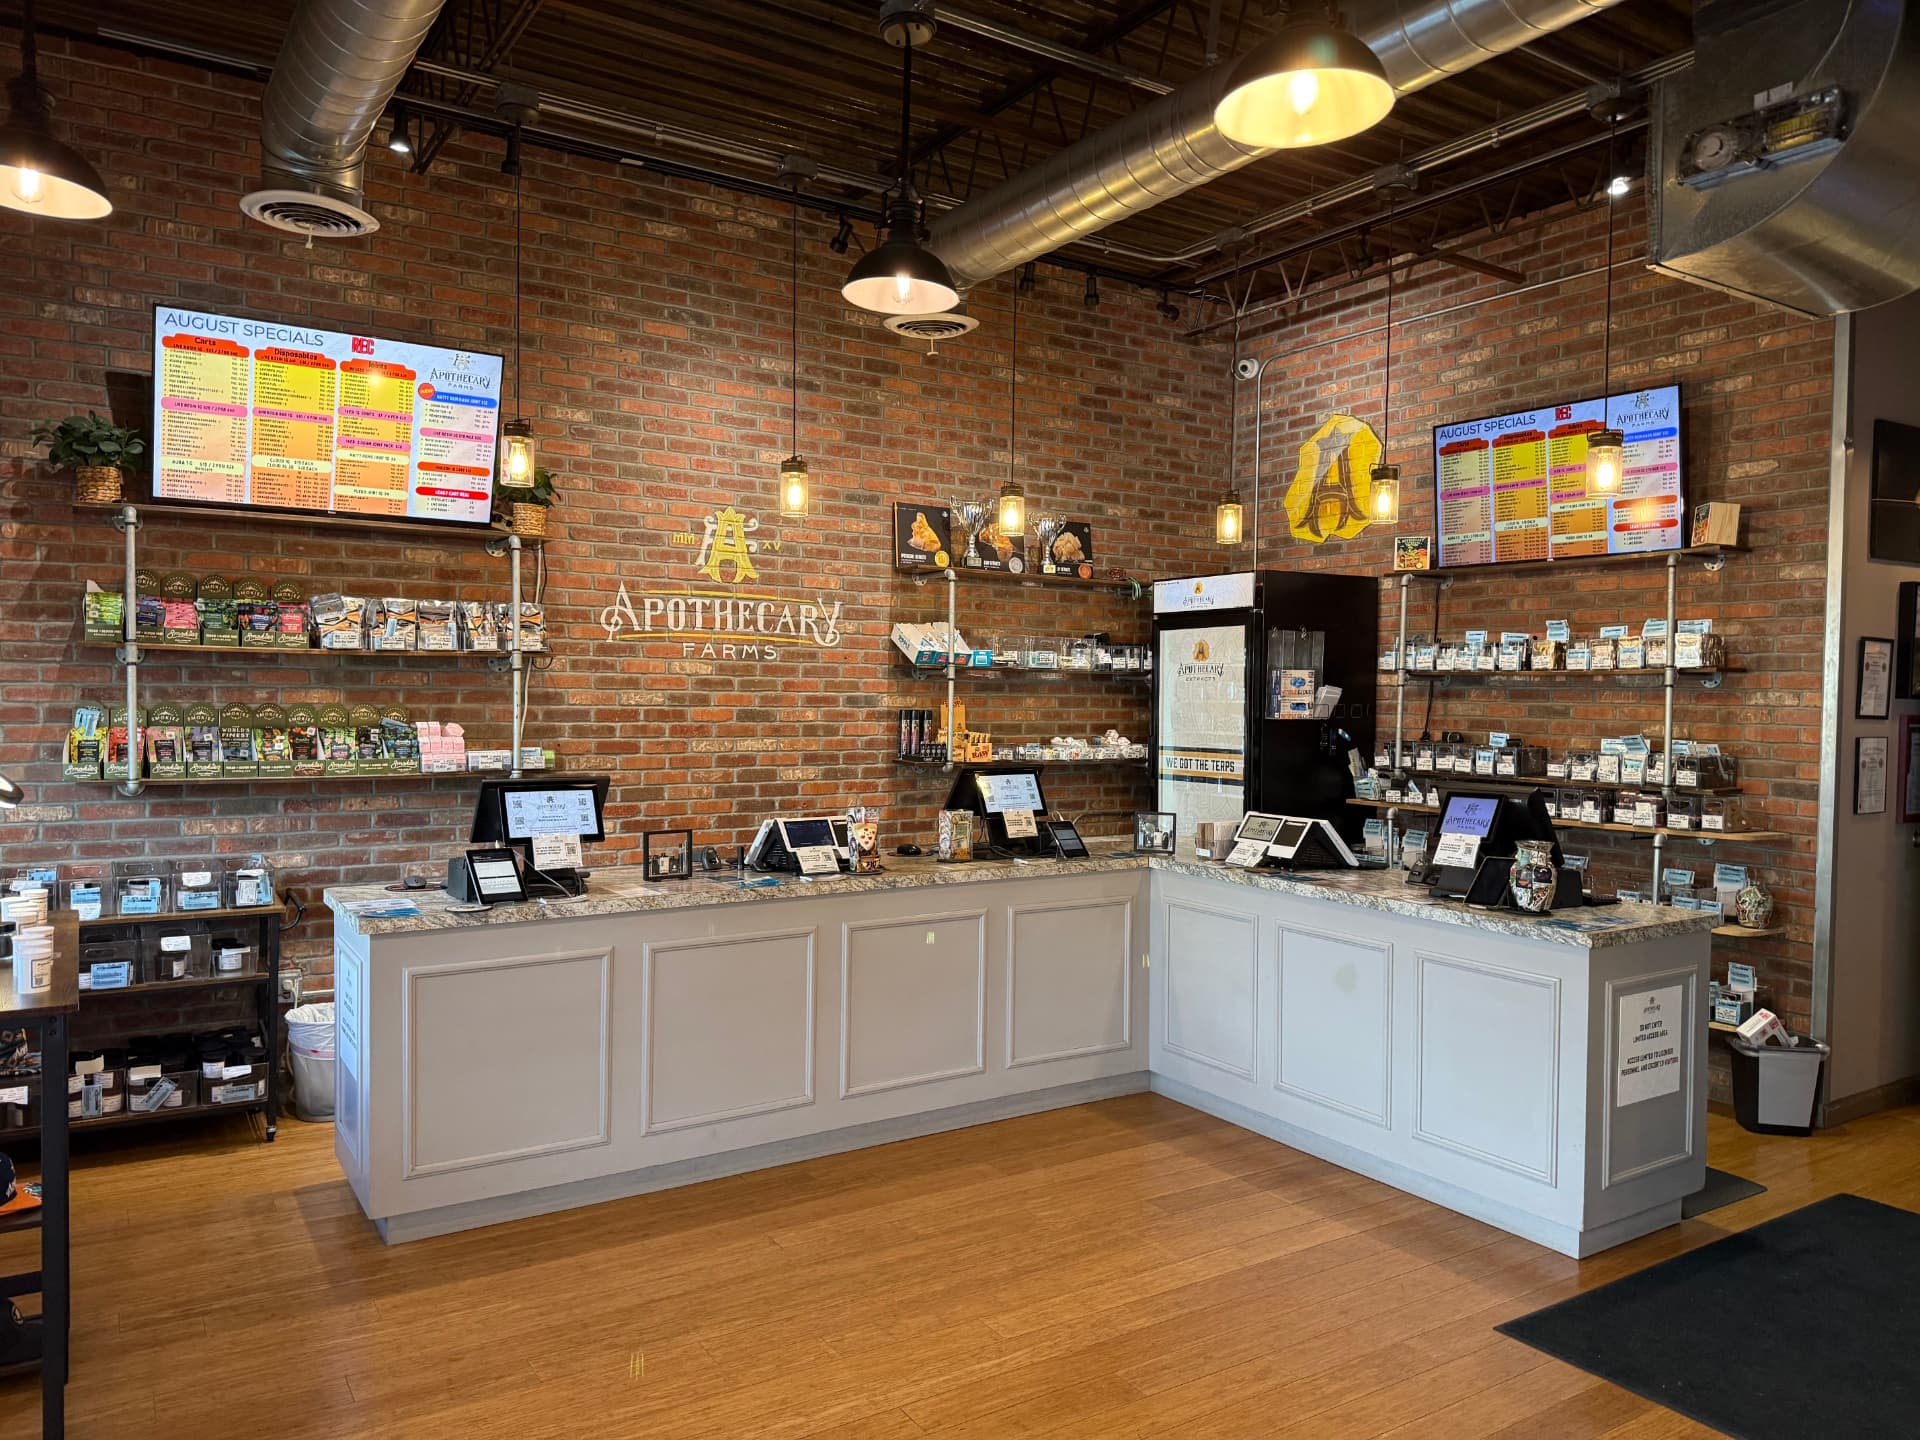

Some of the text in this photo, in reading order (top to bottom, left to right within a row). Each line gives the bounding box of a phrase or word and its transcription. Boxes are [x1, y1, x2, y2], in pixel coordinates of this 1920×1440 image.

[165, 312, 324, 347] AUGUST SPECIALS
[194, 337, 216, 346] Carts
[351, 337, 375, 355] REC
[275, 348, 317, 360] Disposables
[429, 368, 491, 389] APOTHECARY
[1555, 406, 1572, 421] REC
[1616, 407, 1670, 427] APOTHECARY
[1440, 414, 1536, 440] AUGUST SPECIALS
[600, 581, 843, 647] APOTHECARY
[683, 643, 778, 660] FARMS
[1178, 663, 1224, 677] APOTHECARY
[1166, 756, 1235, 772] WE GOT THE TERPS
[1652, 1020, 1662, 1029] ENTER
